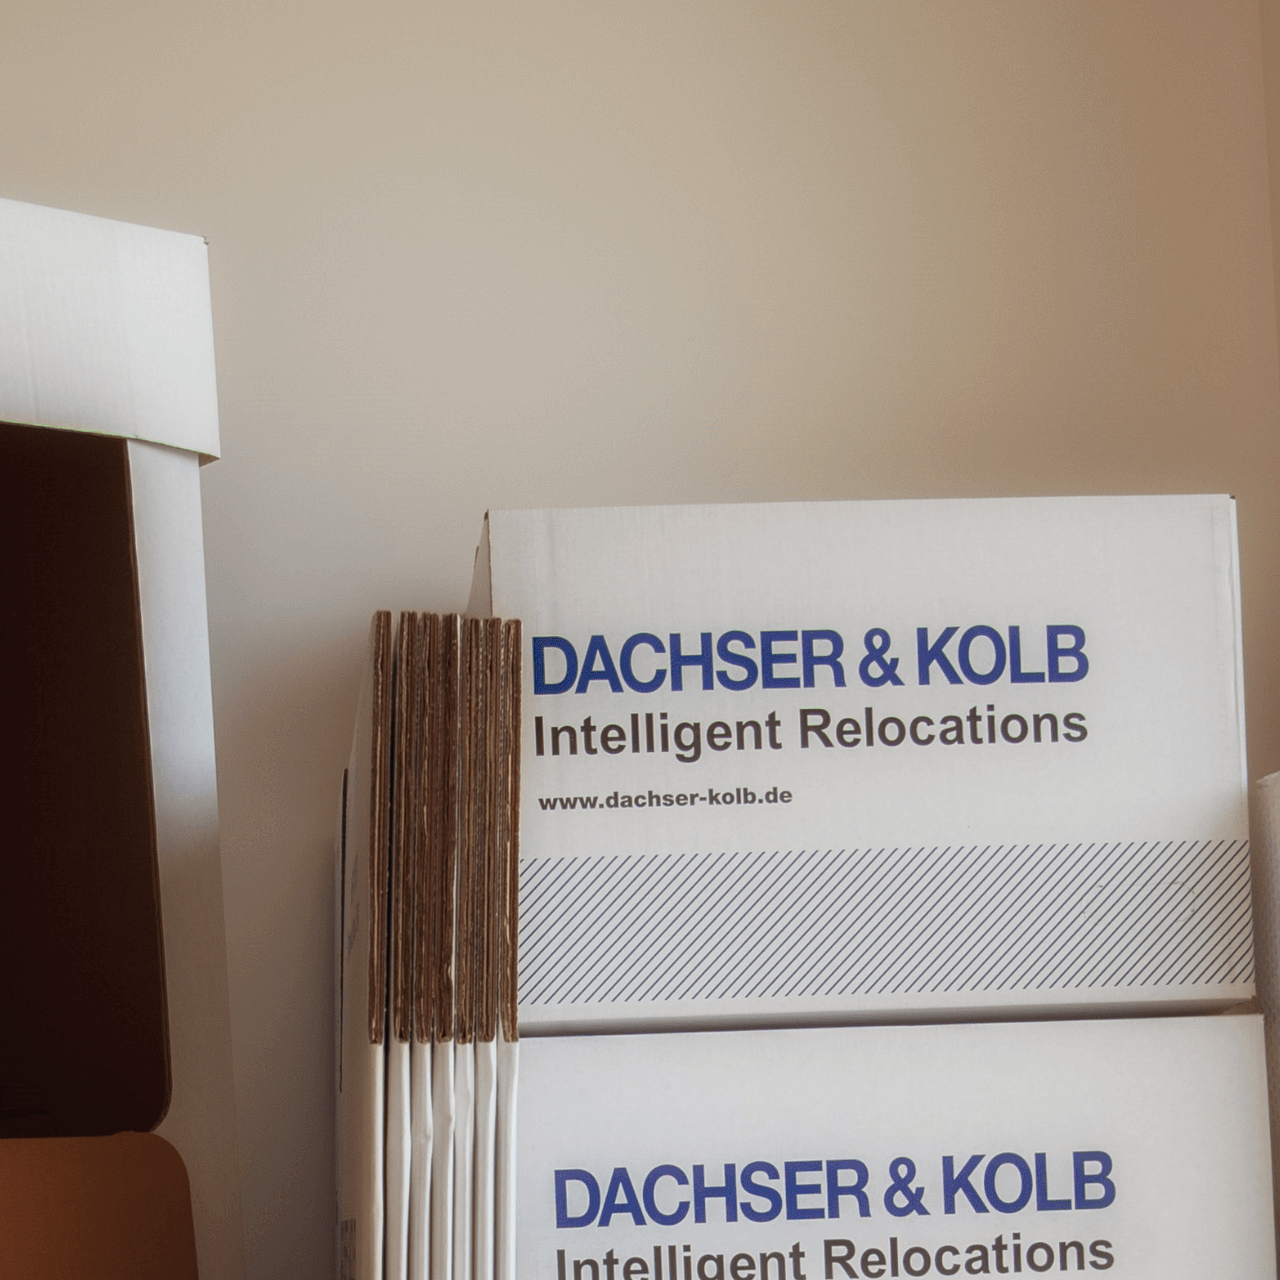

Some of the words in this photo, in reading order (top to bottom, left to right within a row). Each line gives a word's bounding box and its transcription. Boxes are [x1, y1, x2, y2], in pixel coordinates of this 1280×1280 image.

[532, 629, 847, 696] DACHSER
[859, 627, 905, 686] &
[916, 624, 1090, 686] KOLB
[534, 711, 782, 763] Intelligent
[799, 704, 1089, 749] Relocations
[538, 786, 793, 811] www.dachser-kolb.de
[554, 1158, 871, 1230] DACHSER
[883, 1156, 931, 1218] &
[942, 1150, 1117, 1215] KOLB
[823, 1231, 1116, 1280] Relocations
